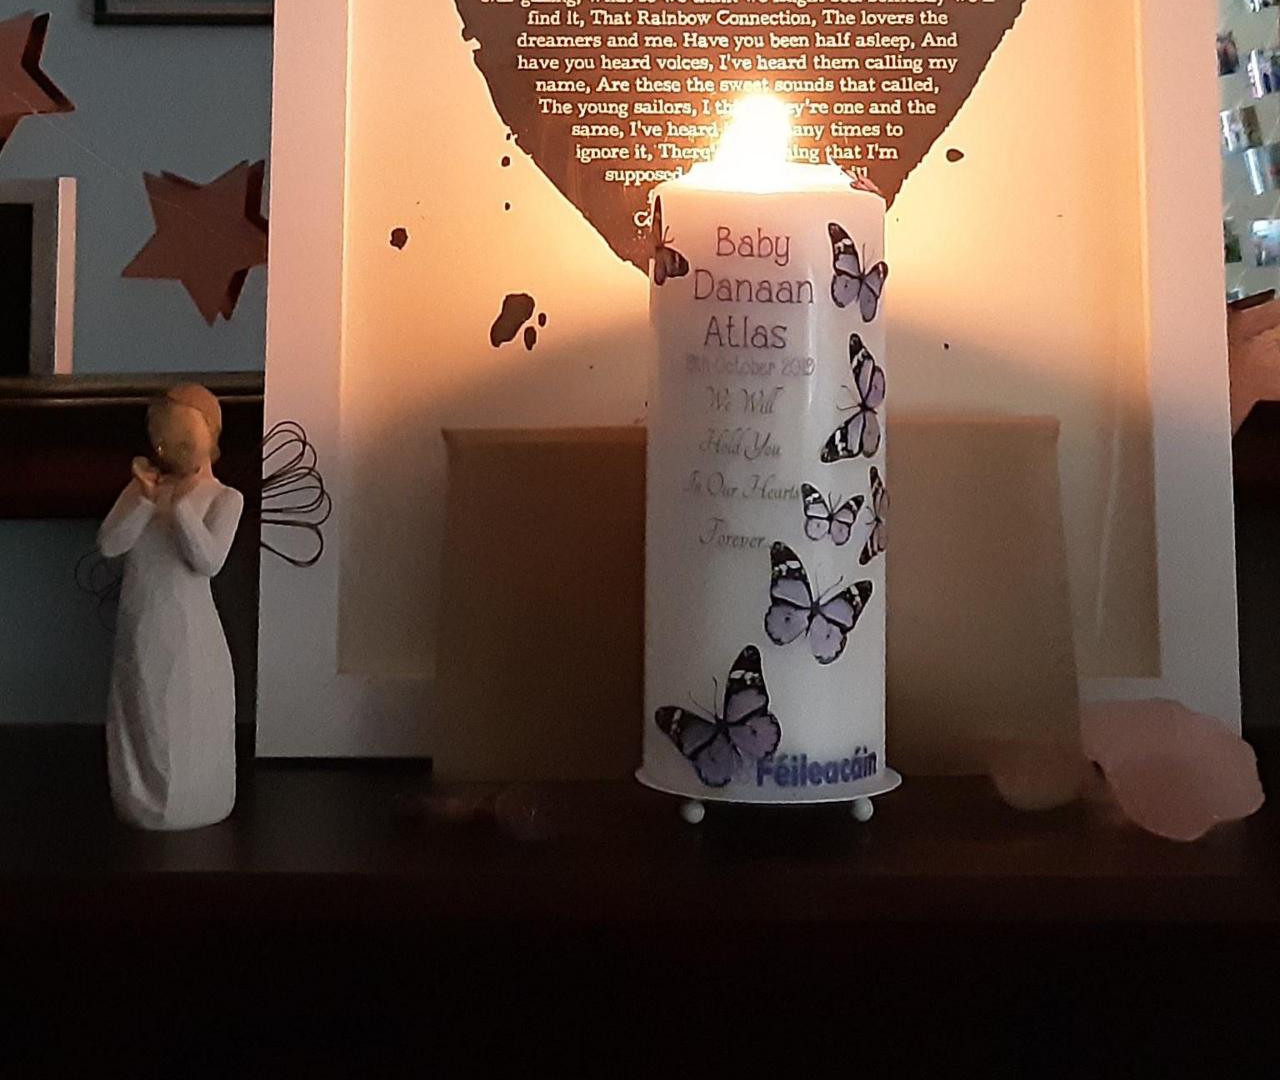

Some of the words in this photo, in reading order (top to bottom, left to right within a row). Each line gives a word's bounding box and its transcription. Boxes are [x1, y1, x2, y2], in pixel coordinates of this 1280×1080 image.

[716, 226, 792, 266] Baby
[693, 268, 815, 304] Danaan
[704, 315, 789, 350] Atlas
[744, 431, 782, 460] You
[707, 471, 738, 497] Our
[699, 517, 766, 548] Forever
